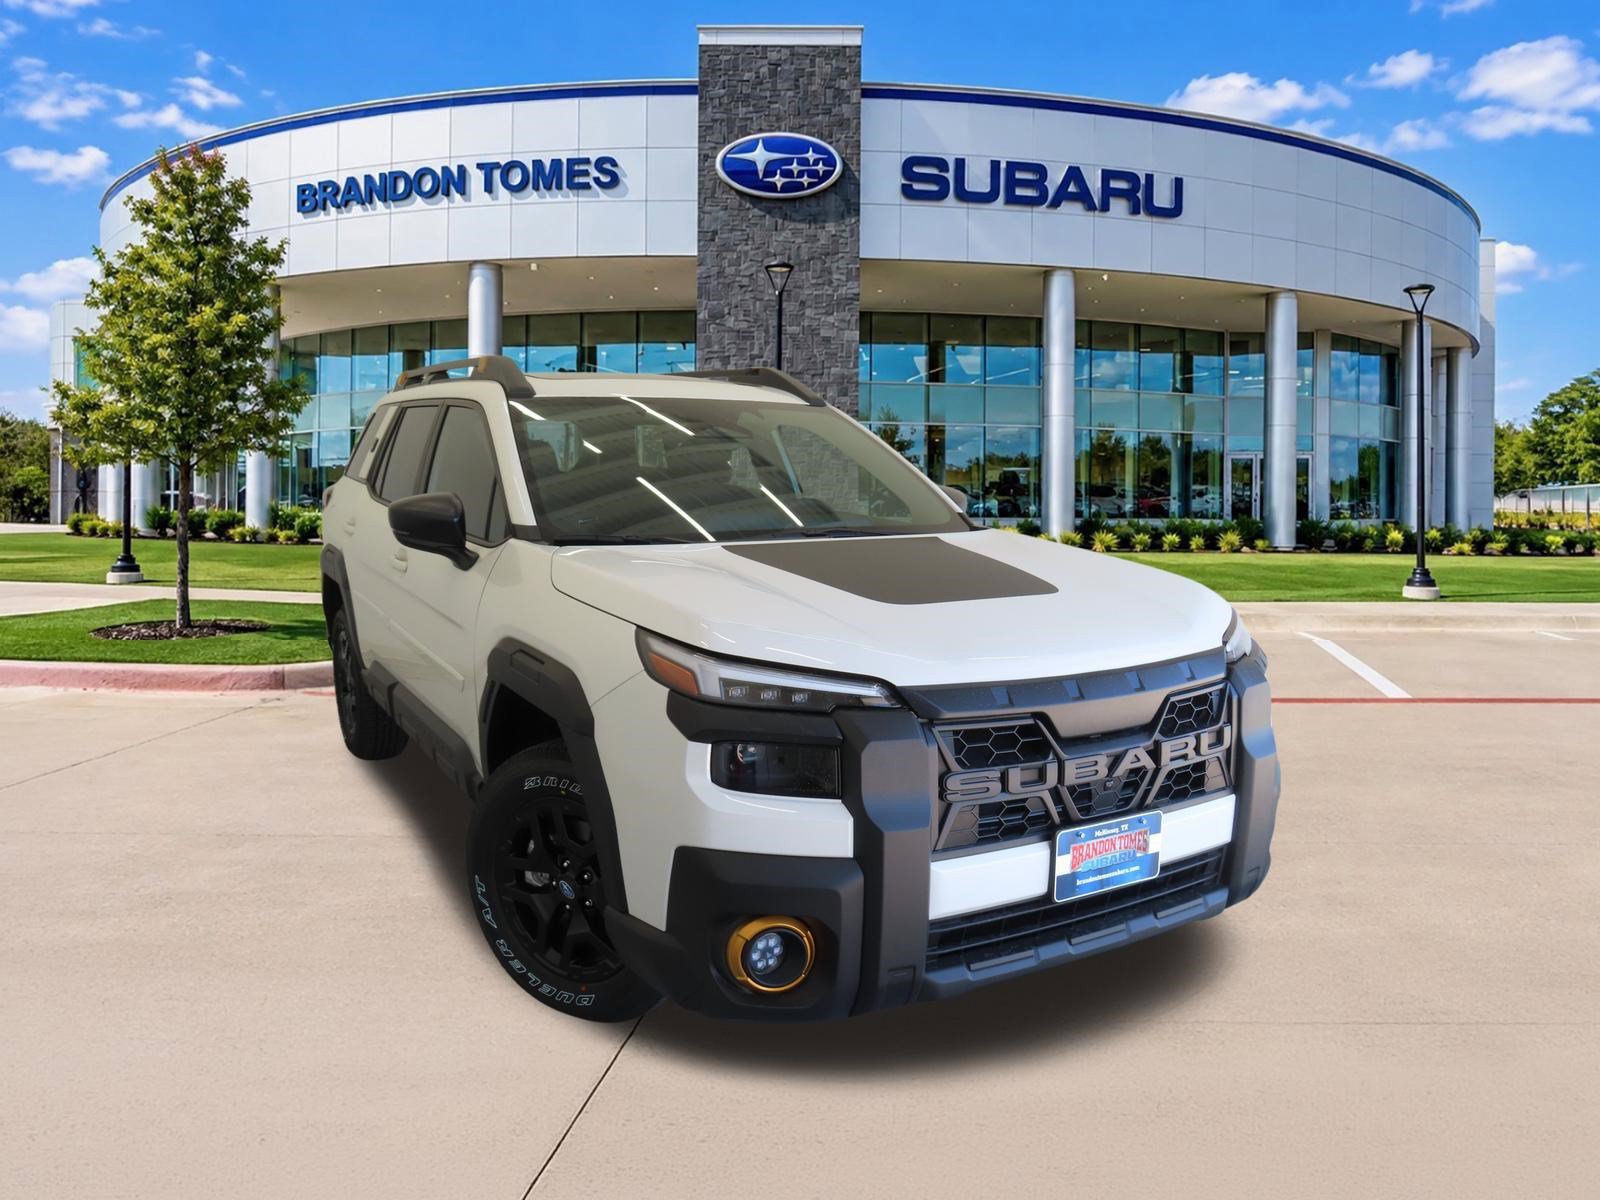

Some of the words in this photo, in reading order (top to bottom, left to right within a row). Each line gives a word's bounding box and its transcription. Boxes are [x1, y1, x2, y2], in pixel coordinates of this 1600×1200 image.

[296, 162, 467, 214] BRANDON
[476, 156, 621, 194] TOMES
[901, 155, 1184, 218] SUBARU
[523, 776, 584, 796] BRID
[943, 724, 1232, 802] SUBARU
[1071, 837, 1118, 871] BRANDON
[1118, 829, 1149, 854] TOMES
[1081, 849, 1137, 872] SUBARU
[474, 874, 498, 929] A/T
[496, 939, 595, 1006] DUELER
